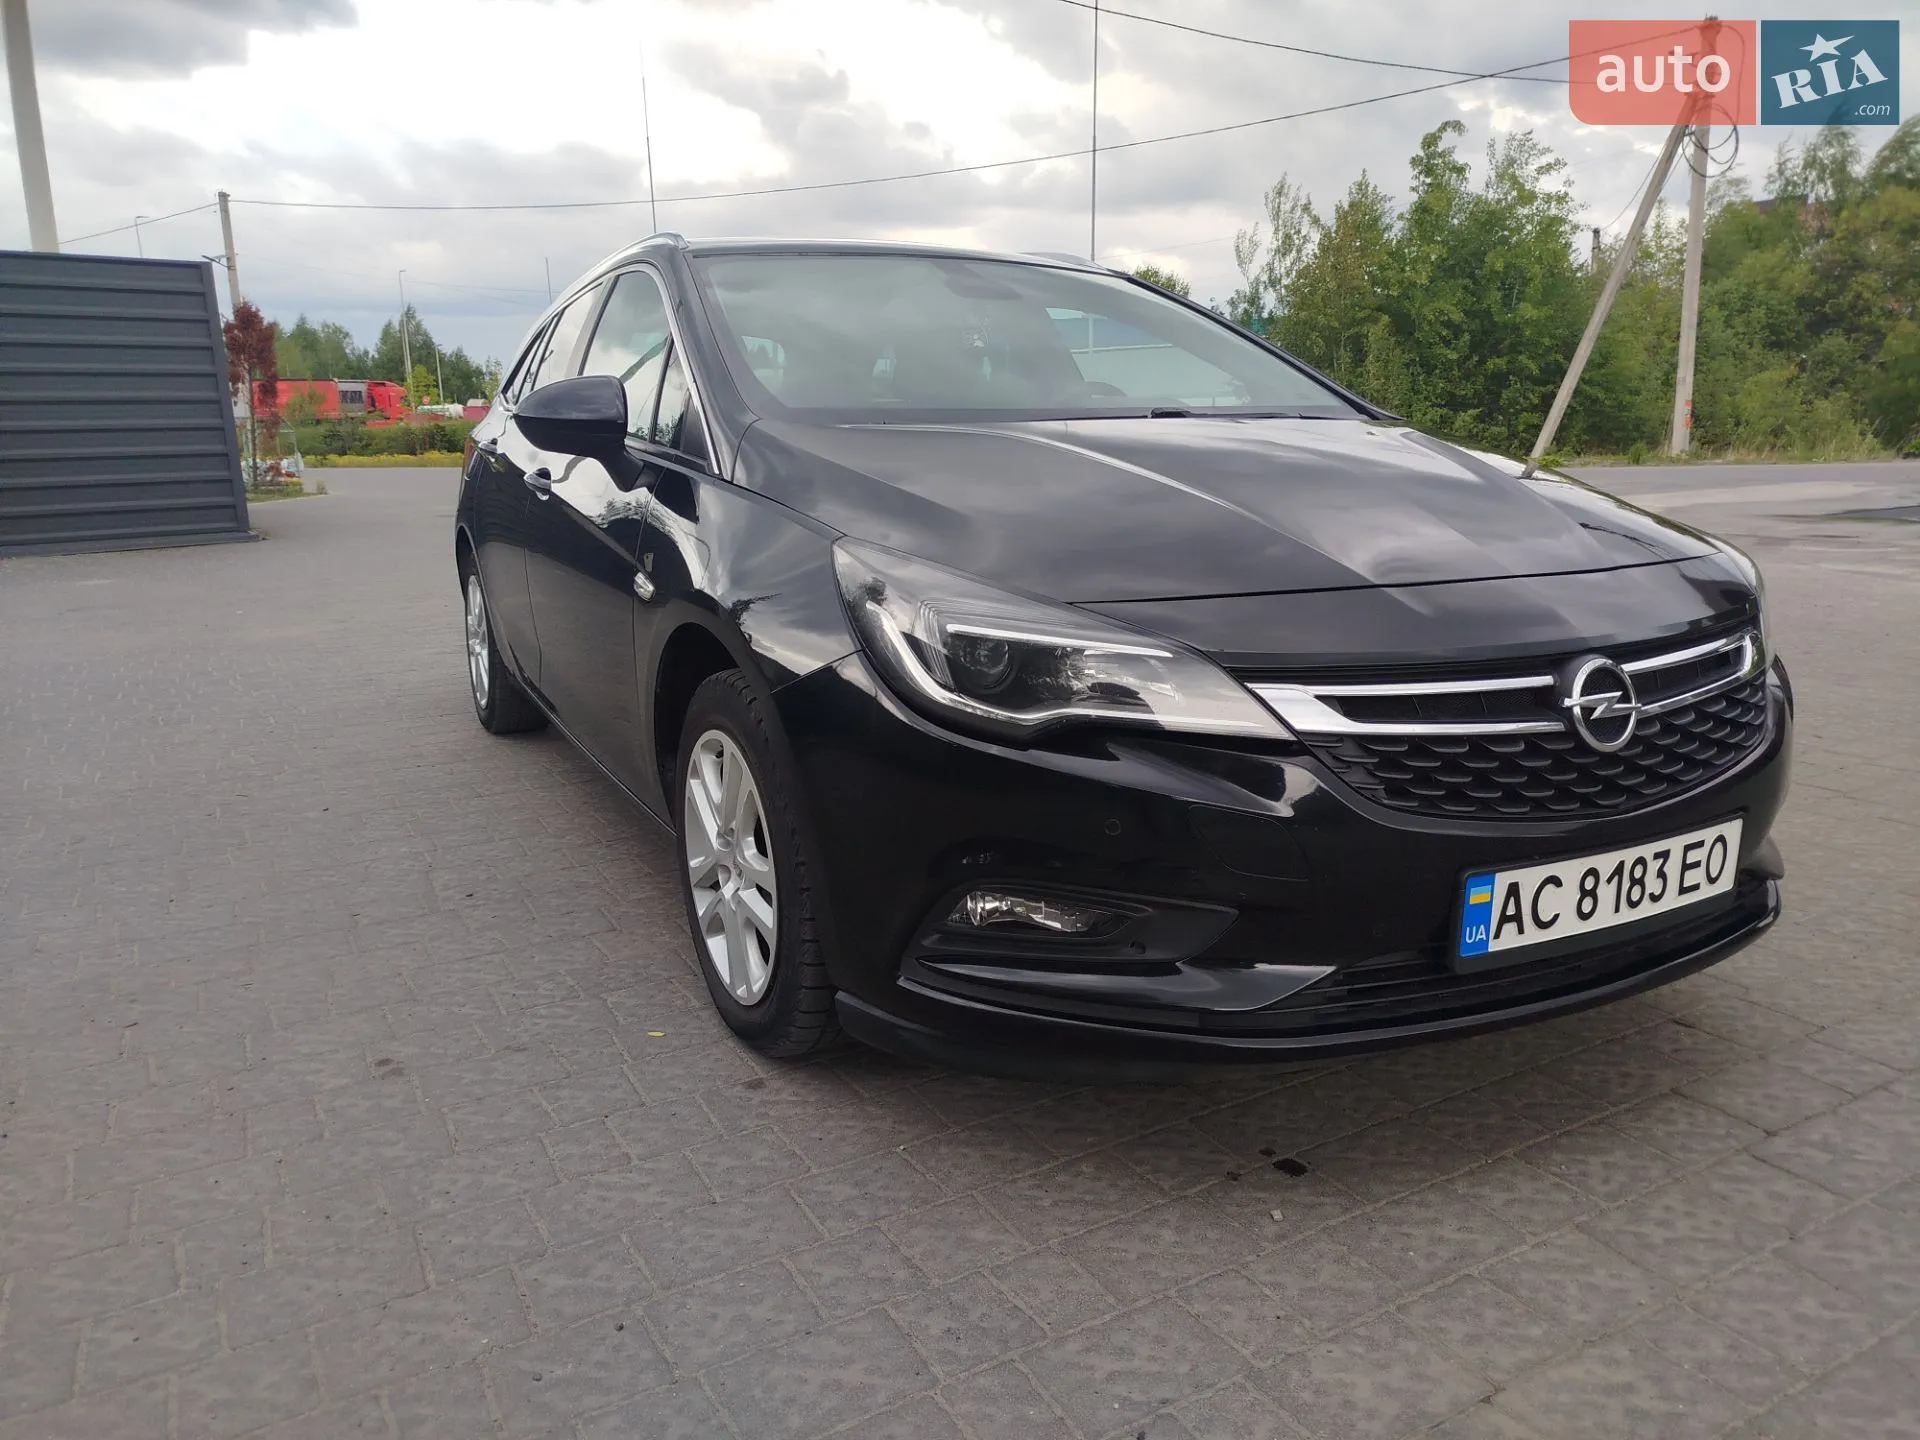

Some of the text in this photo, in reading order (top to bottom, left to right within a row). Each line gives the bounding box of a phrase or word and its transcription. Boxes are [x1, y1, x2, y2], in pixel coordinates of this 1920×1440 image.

[1493, 833, 1728, 940] AC 8183 EO
[1465, 924, 1487, 944] UA
